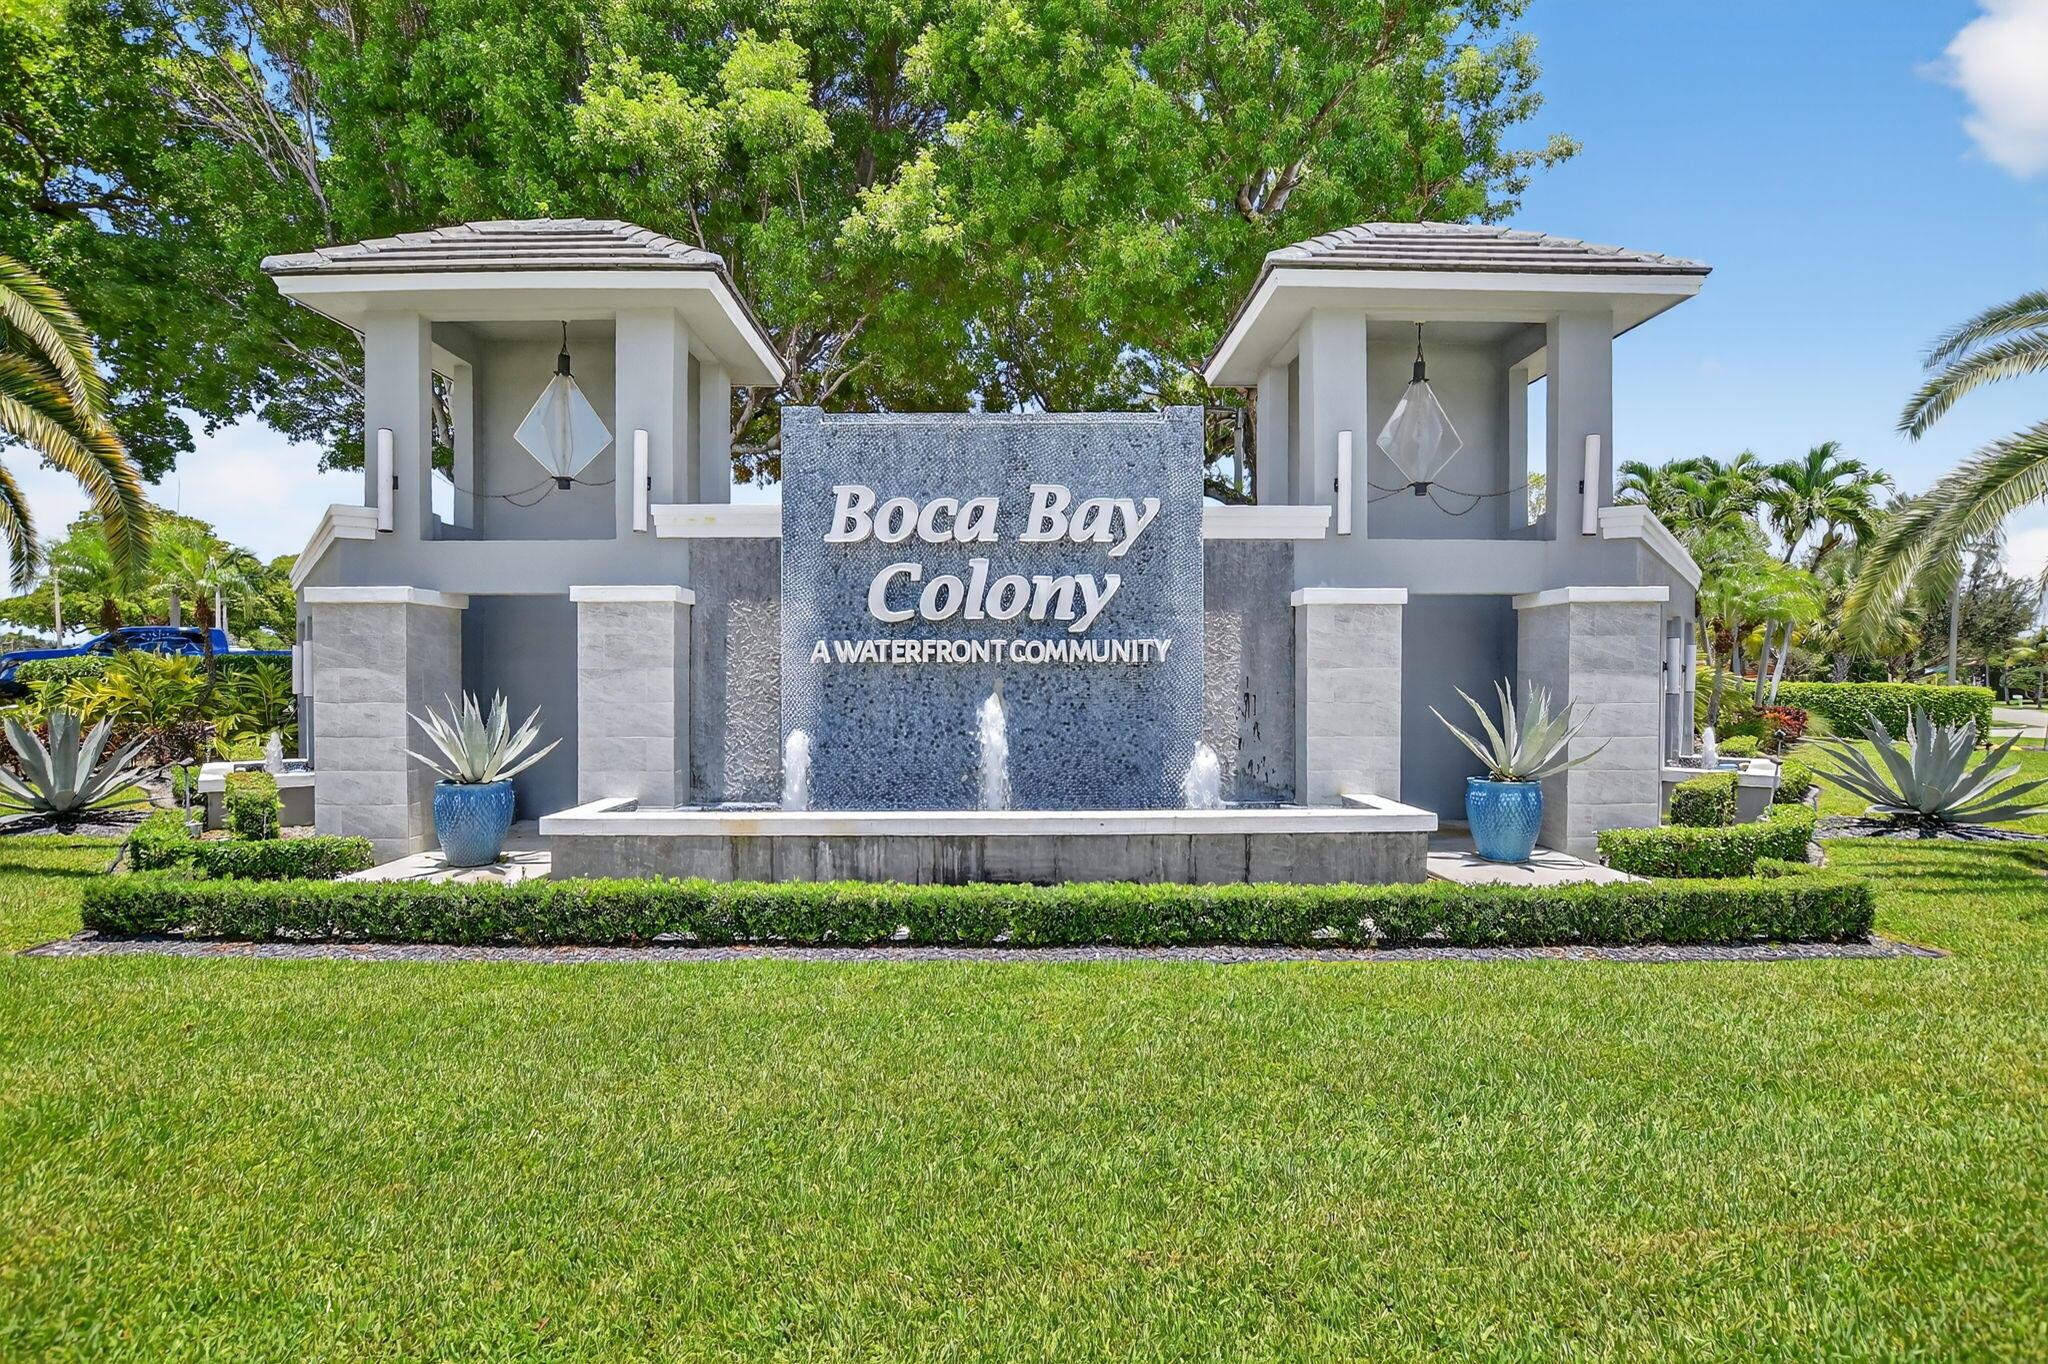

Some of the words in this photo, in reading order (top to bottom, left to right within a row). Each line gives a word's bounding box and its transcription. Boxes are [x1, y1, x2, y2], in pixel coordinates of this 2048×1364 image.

[824, 485, 1000, 544] Boca
[1019, 484, 1161, 557] Bay
[868, 558, 1122, 633] Colony
[810, 640, 831, 664] A
[834, 639, 1007, 664] WATERFRONT
[1009, 639, 1173, 664] COMMUNITY
